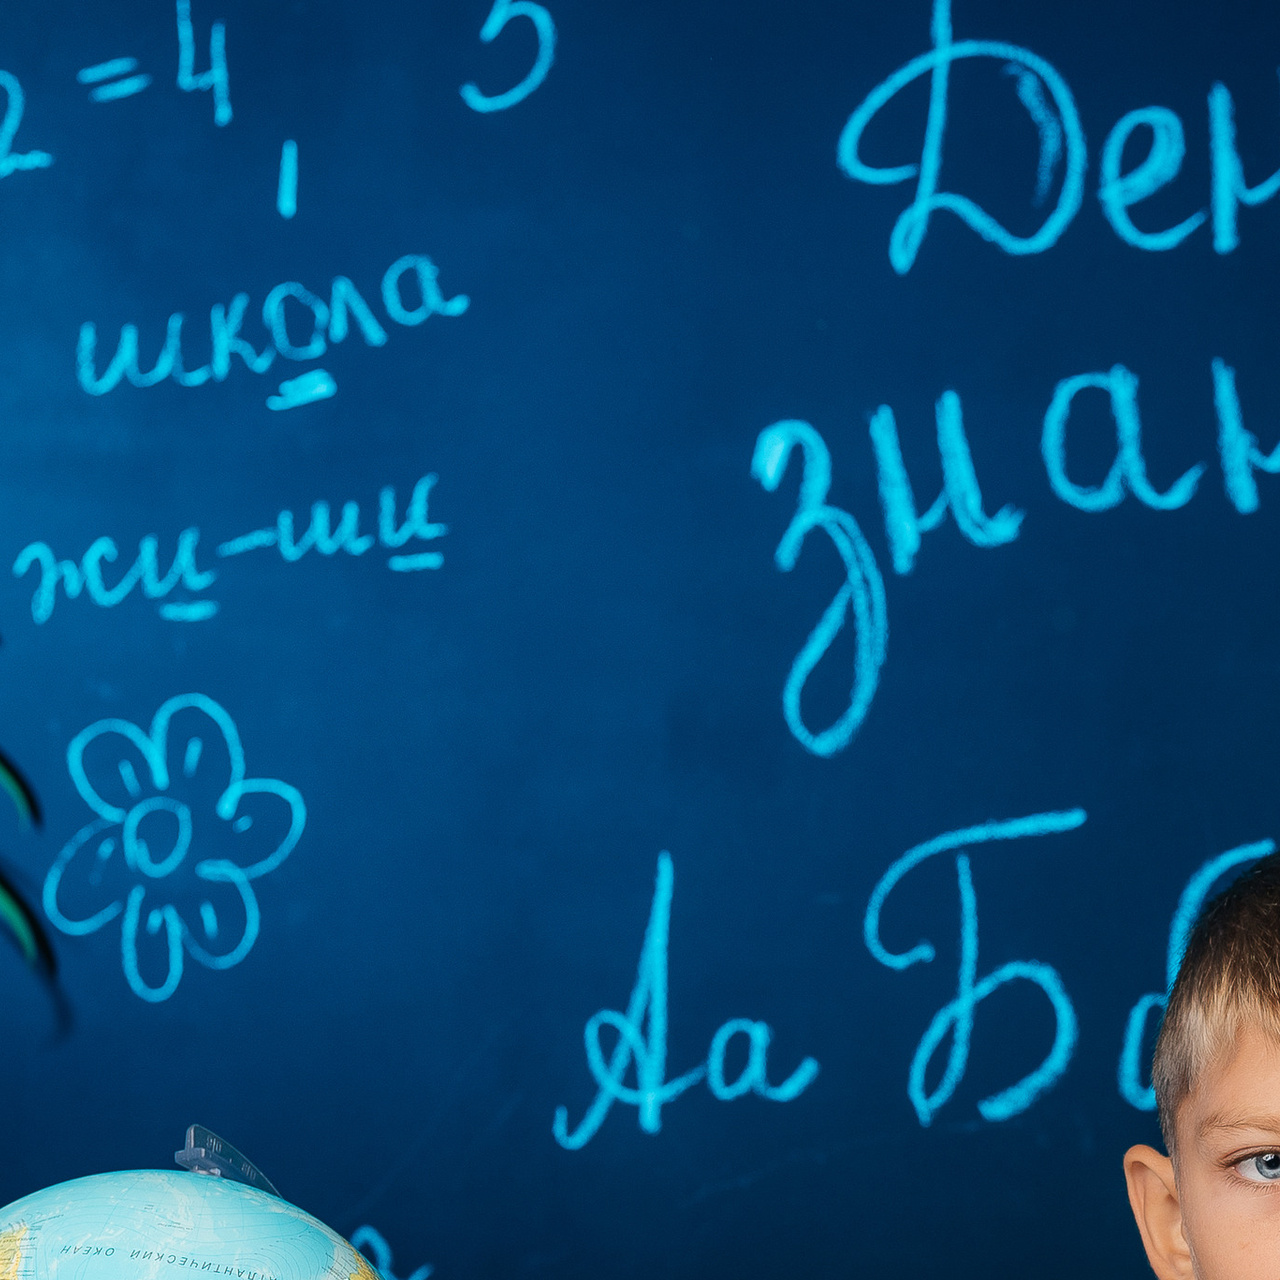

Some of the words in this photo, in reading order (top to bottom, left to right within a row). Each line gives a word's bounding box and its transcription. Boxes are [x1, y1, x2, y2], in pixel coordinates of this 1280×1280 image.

[77, 253, 471, 396] школа
[552, 848, 820, 1150] Аа
[60, 1245, 115, 1257] ОКЕАН
